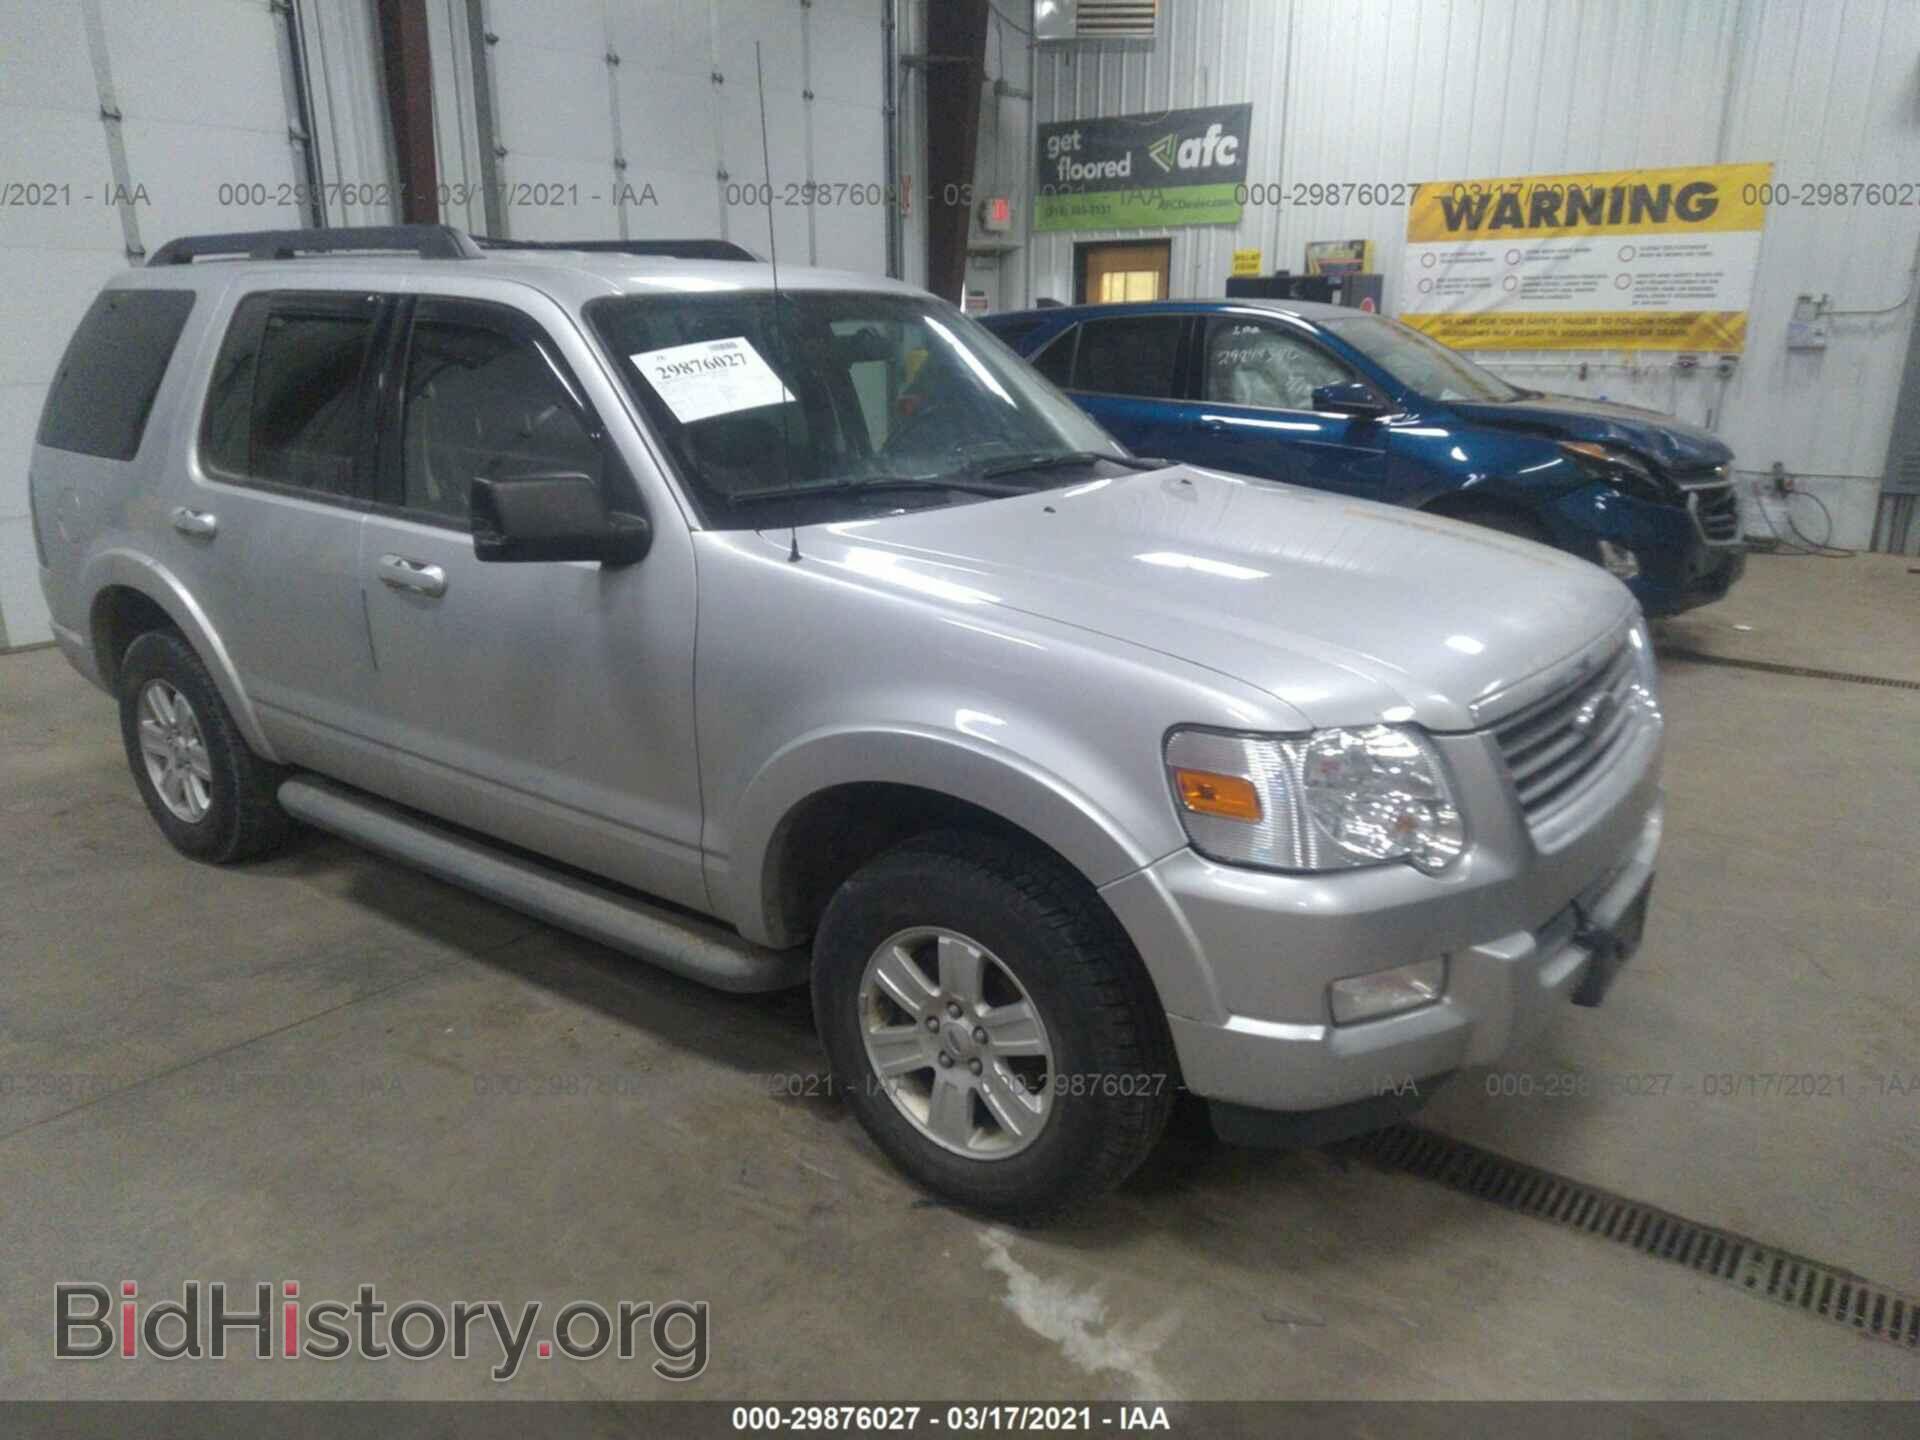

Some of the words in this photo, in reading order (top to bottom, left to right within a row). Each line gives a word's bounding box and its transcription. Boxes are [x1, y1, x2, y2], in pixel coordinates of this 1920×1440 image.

[1047, 129, 1082, 159] get
[1176, 123, 1238, 170] afc
[1056, 151, 1132, 182] floored
[1440, 181, 1720, 233] WARNING
[655, 352, 748, 380] 29876027
